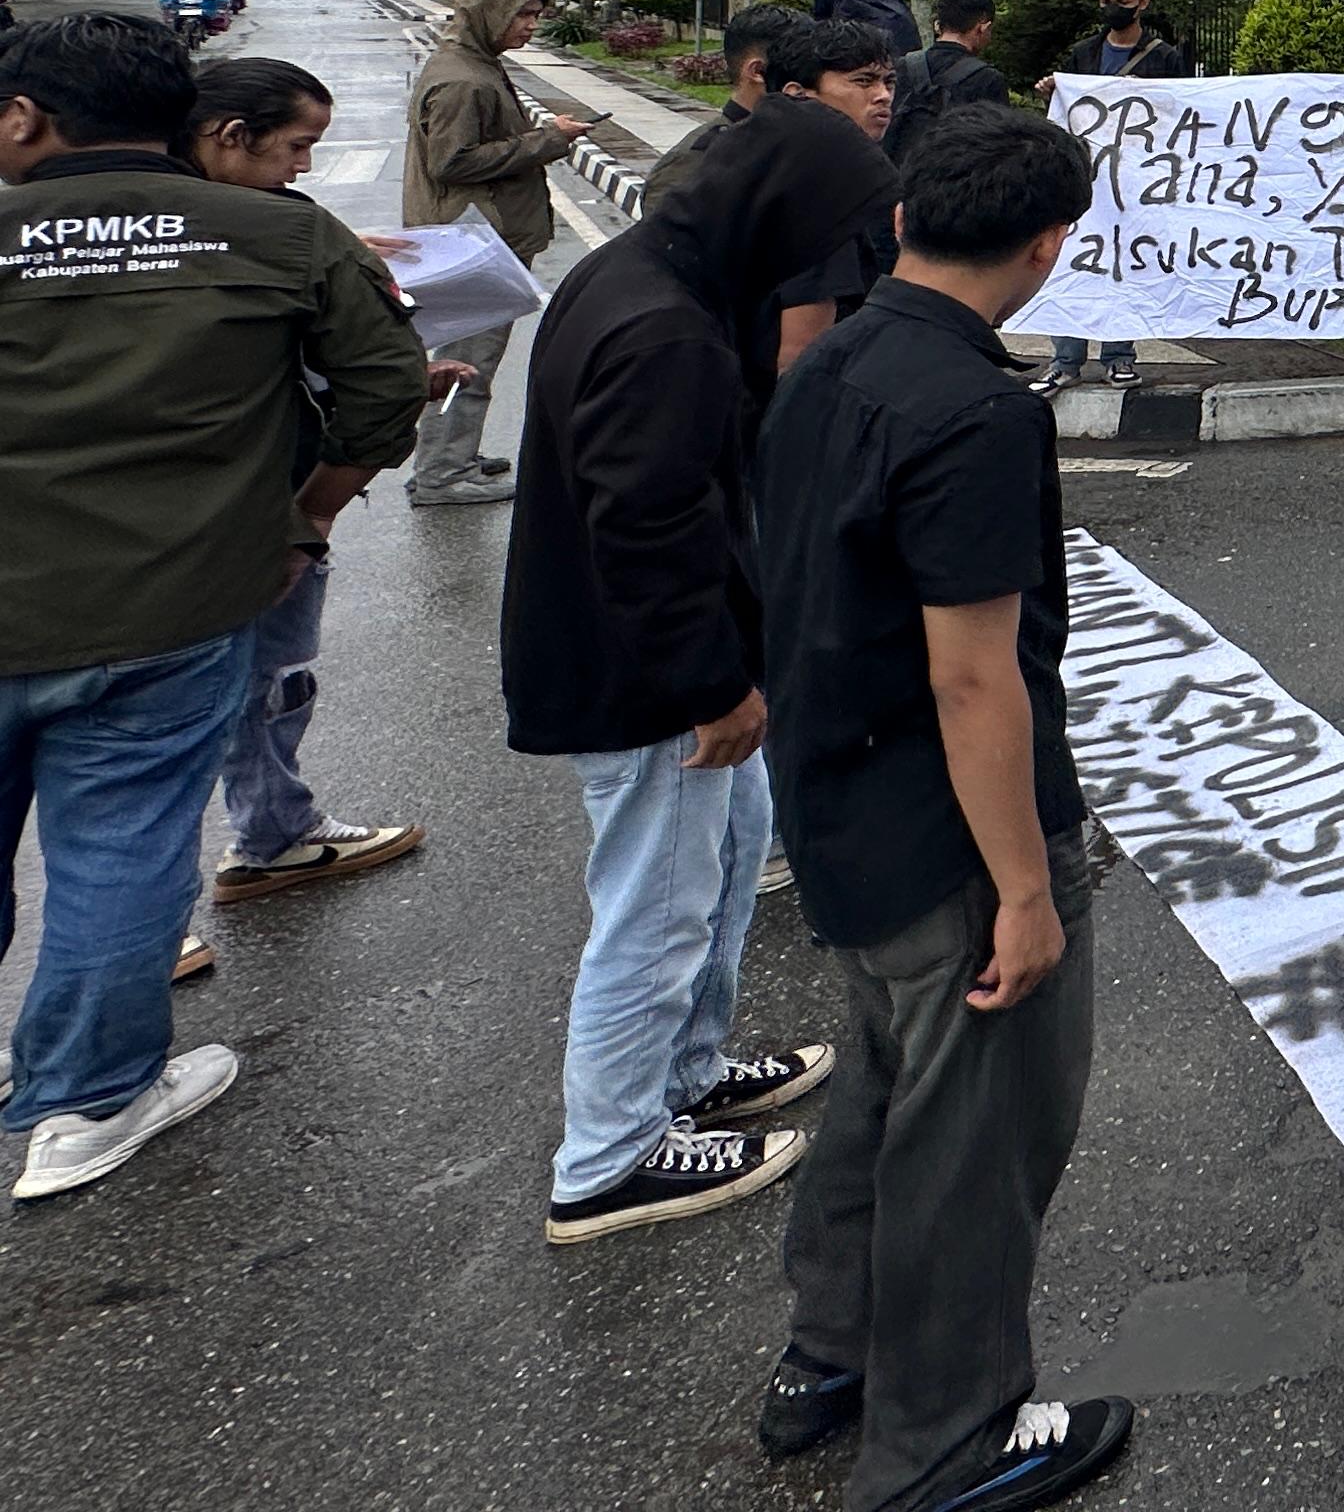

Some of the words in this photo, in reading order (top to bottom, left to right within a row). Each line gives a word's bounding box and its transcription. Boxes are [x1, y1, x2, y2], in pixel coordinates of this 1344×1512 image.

[21, 214, 186, 248] KPMKB
[62, 246, 125, 261] Pelajar
[131, 240, 230, 258] Mahasiswa
[21, 263, 120, 280] Kabupaten
[126, 258, 180, 273] Berau
